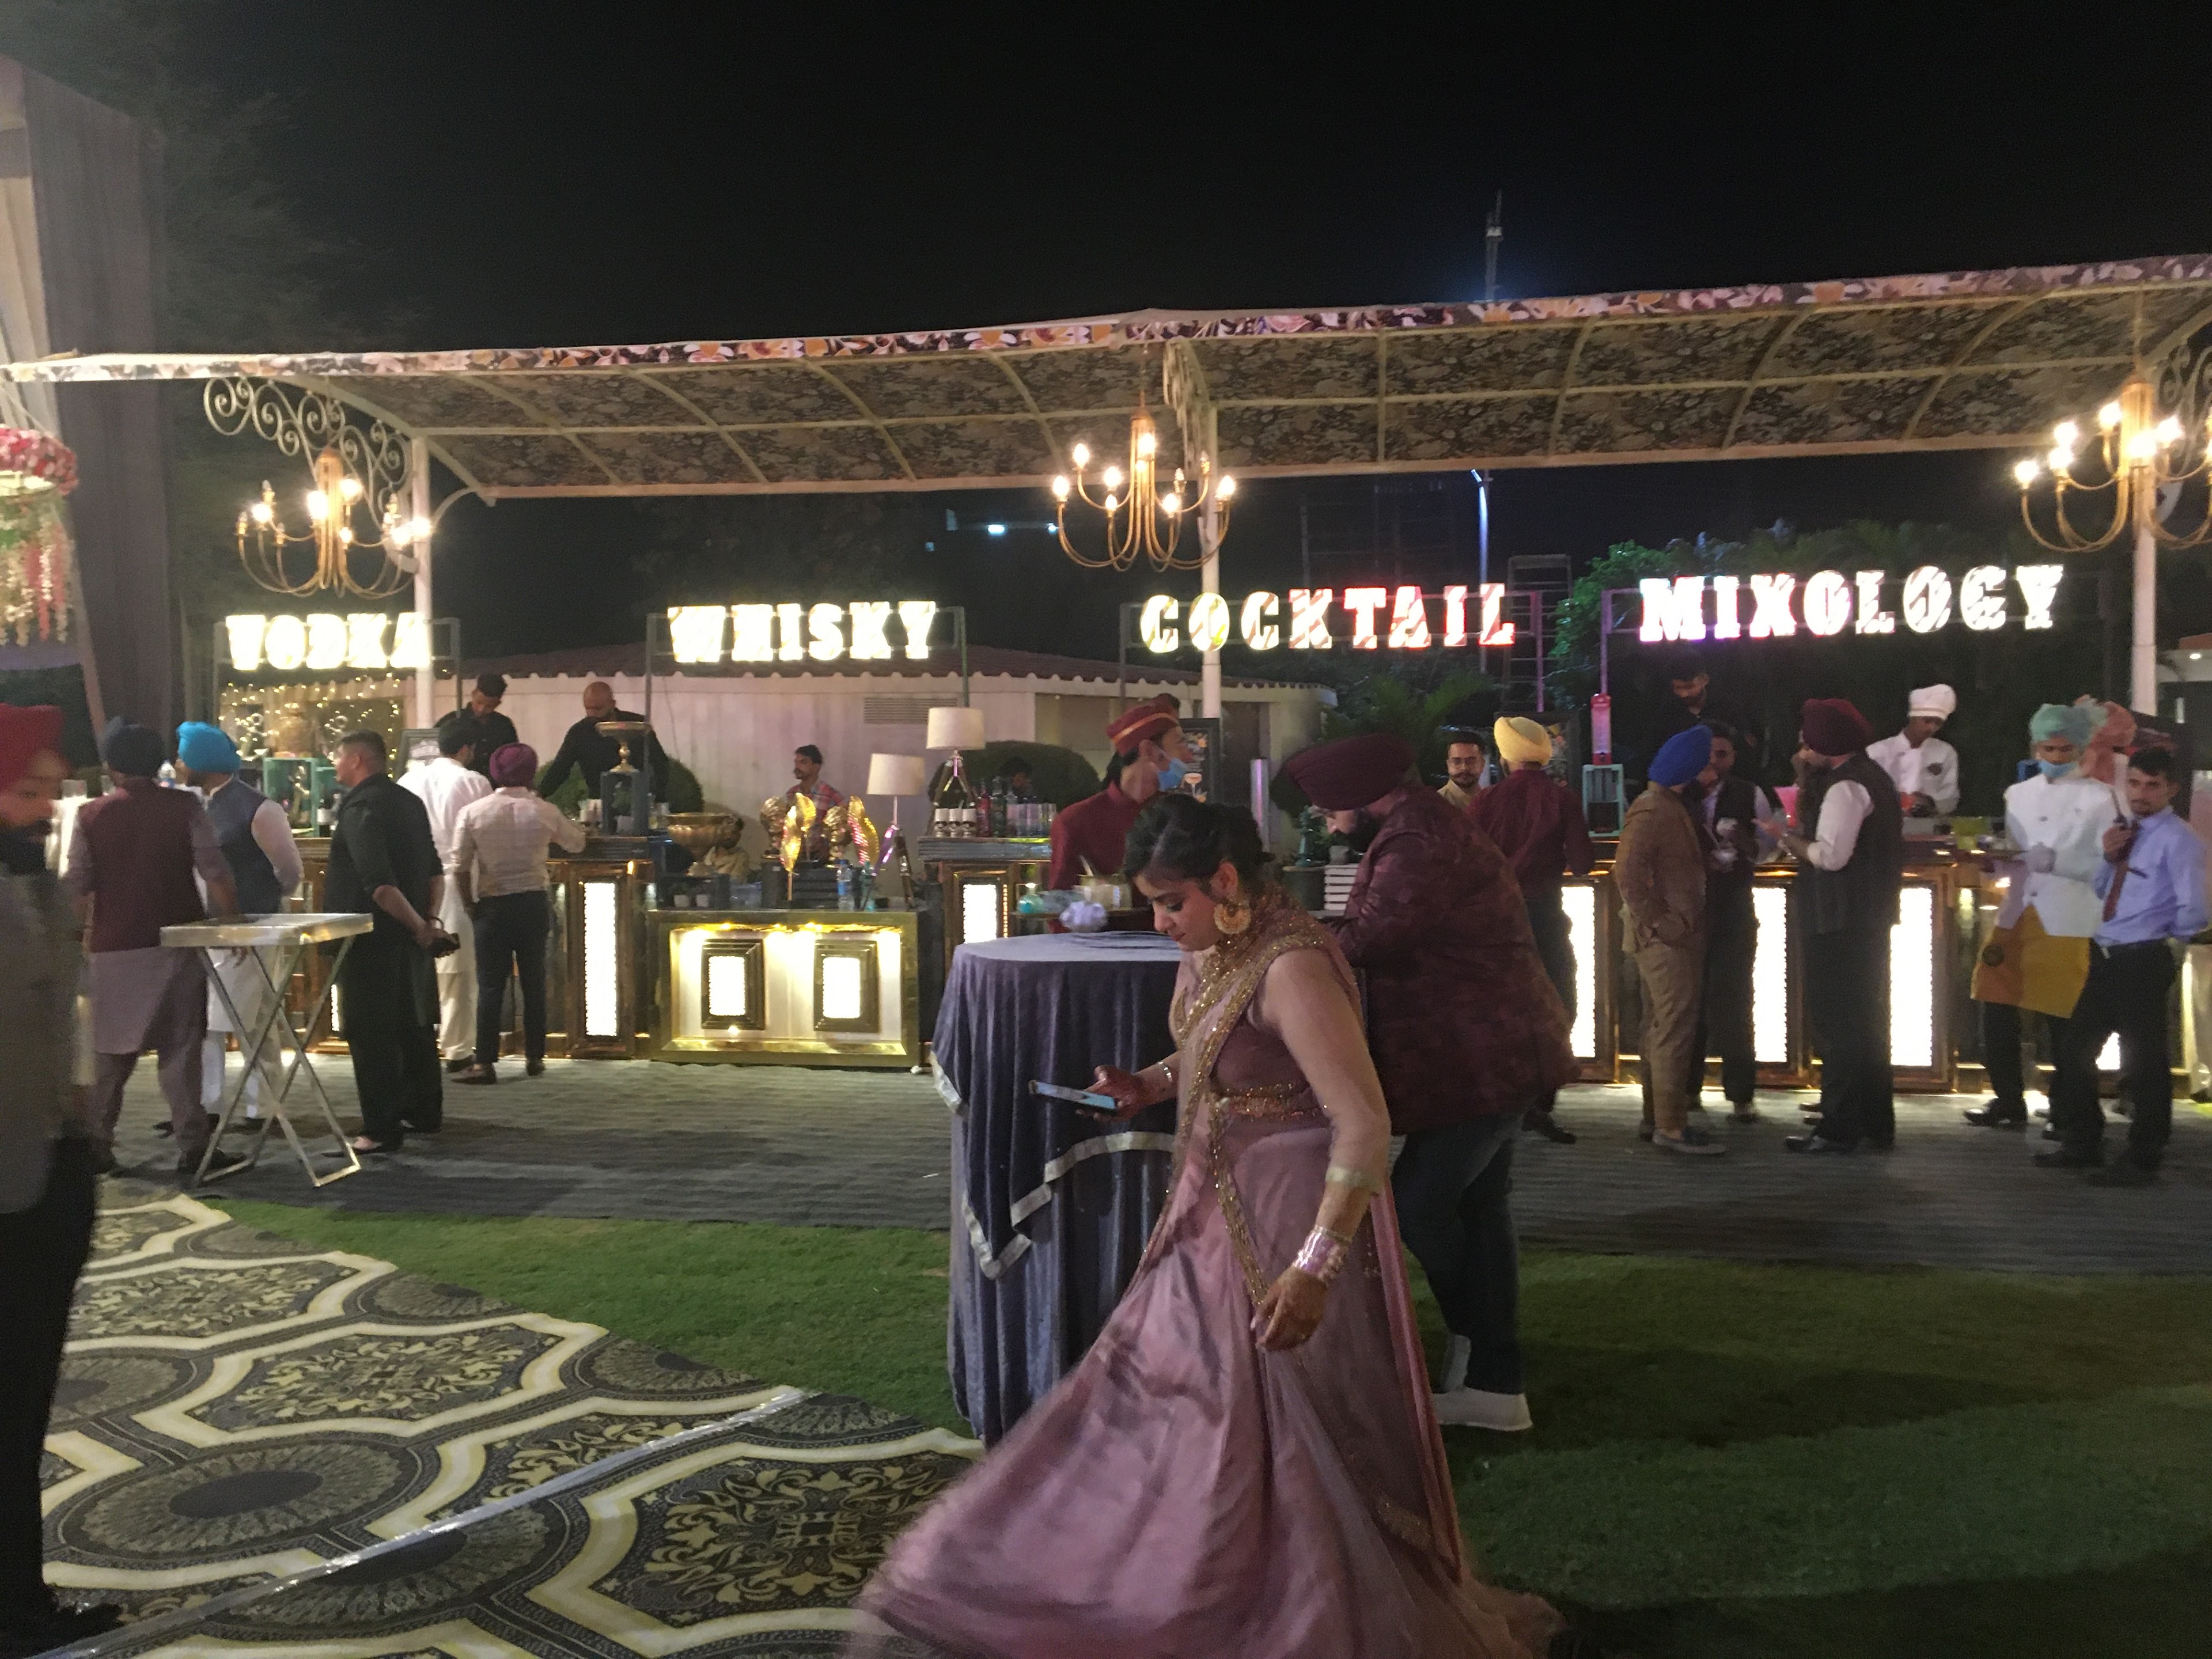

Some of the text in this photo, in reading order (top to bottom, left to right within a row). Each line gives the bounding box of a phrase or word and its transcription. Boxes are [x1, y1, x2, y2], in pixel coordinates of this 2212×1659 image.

[668, 601, 936, 662] WHISKY
[1140, 583, 1515, 653] COCKTAIL
[1639, 565, 2064, 642] MIXOLOGY
[225, 612, 431, 670] VODKA
